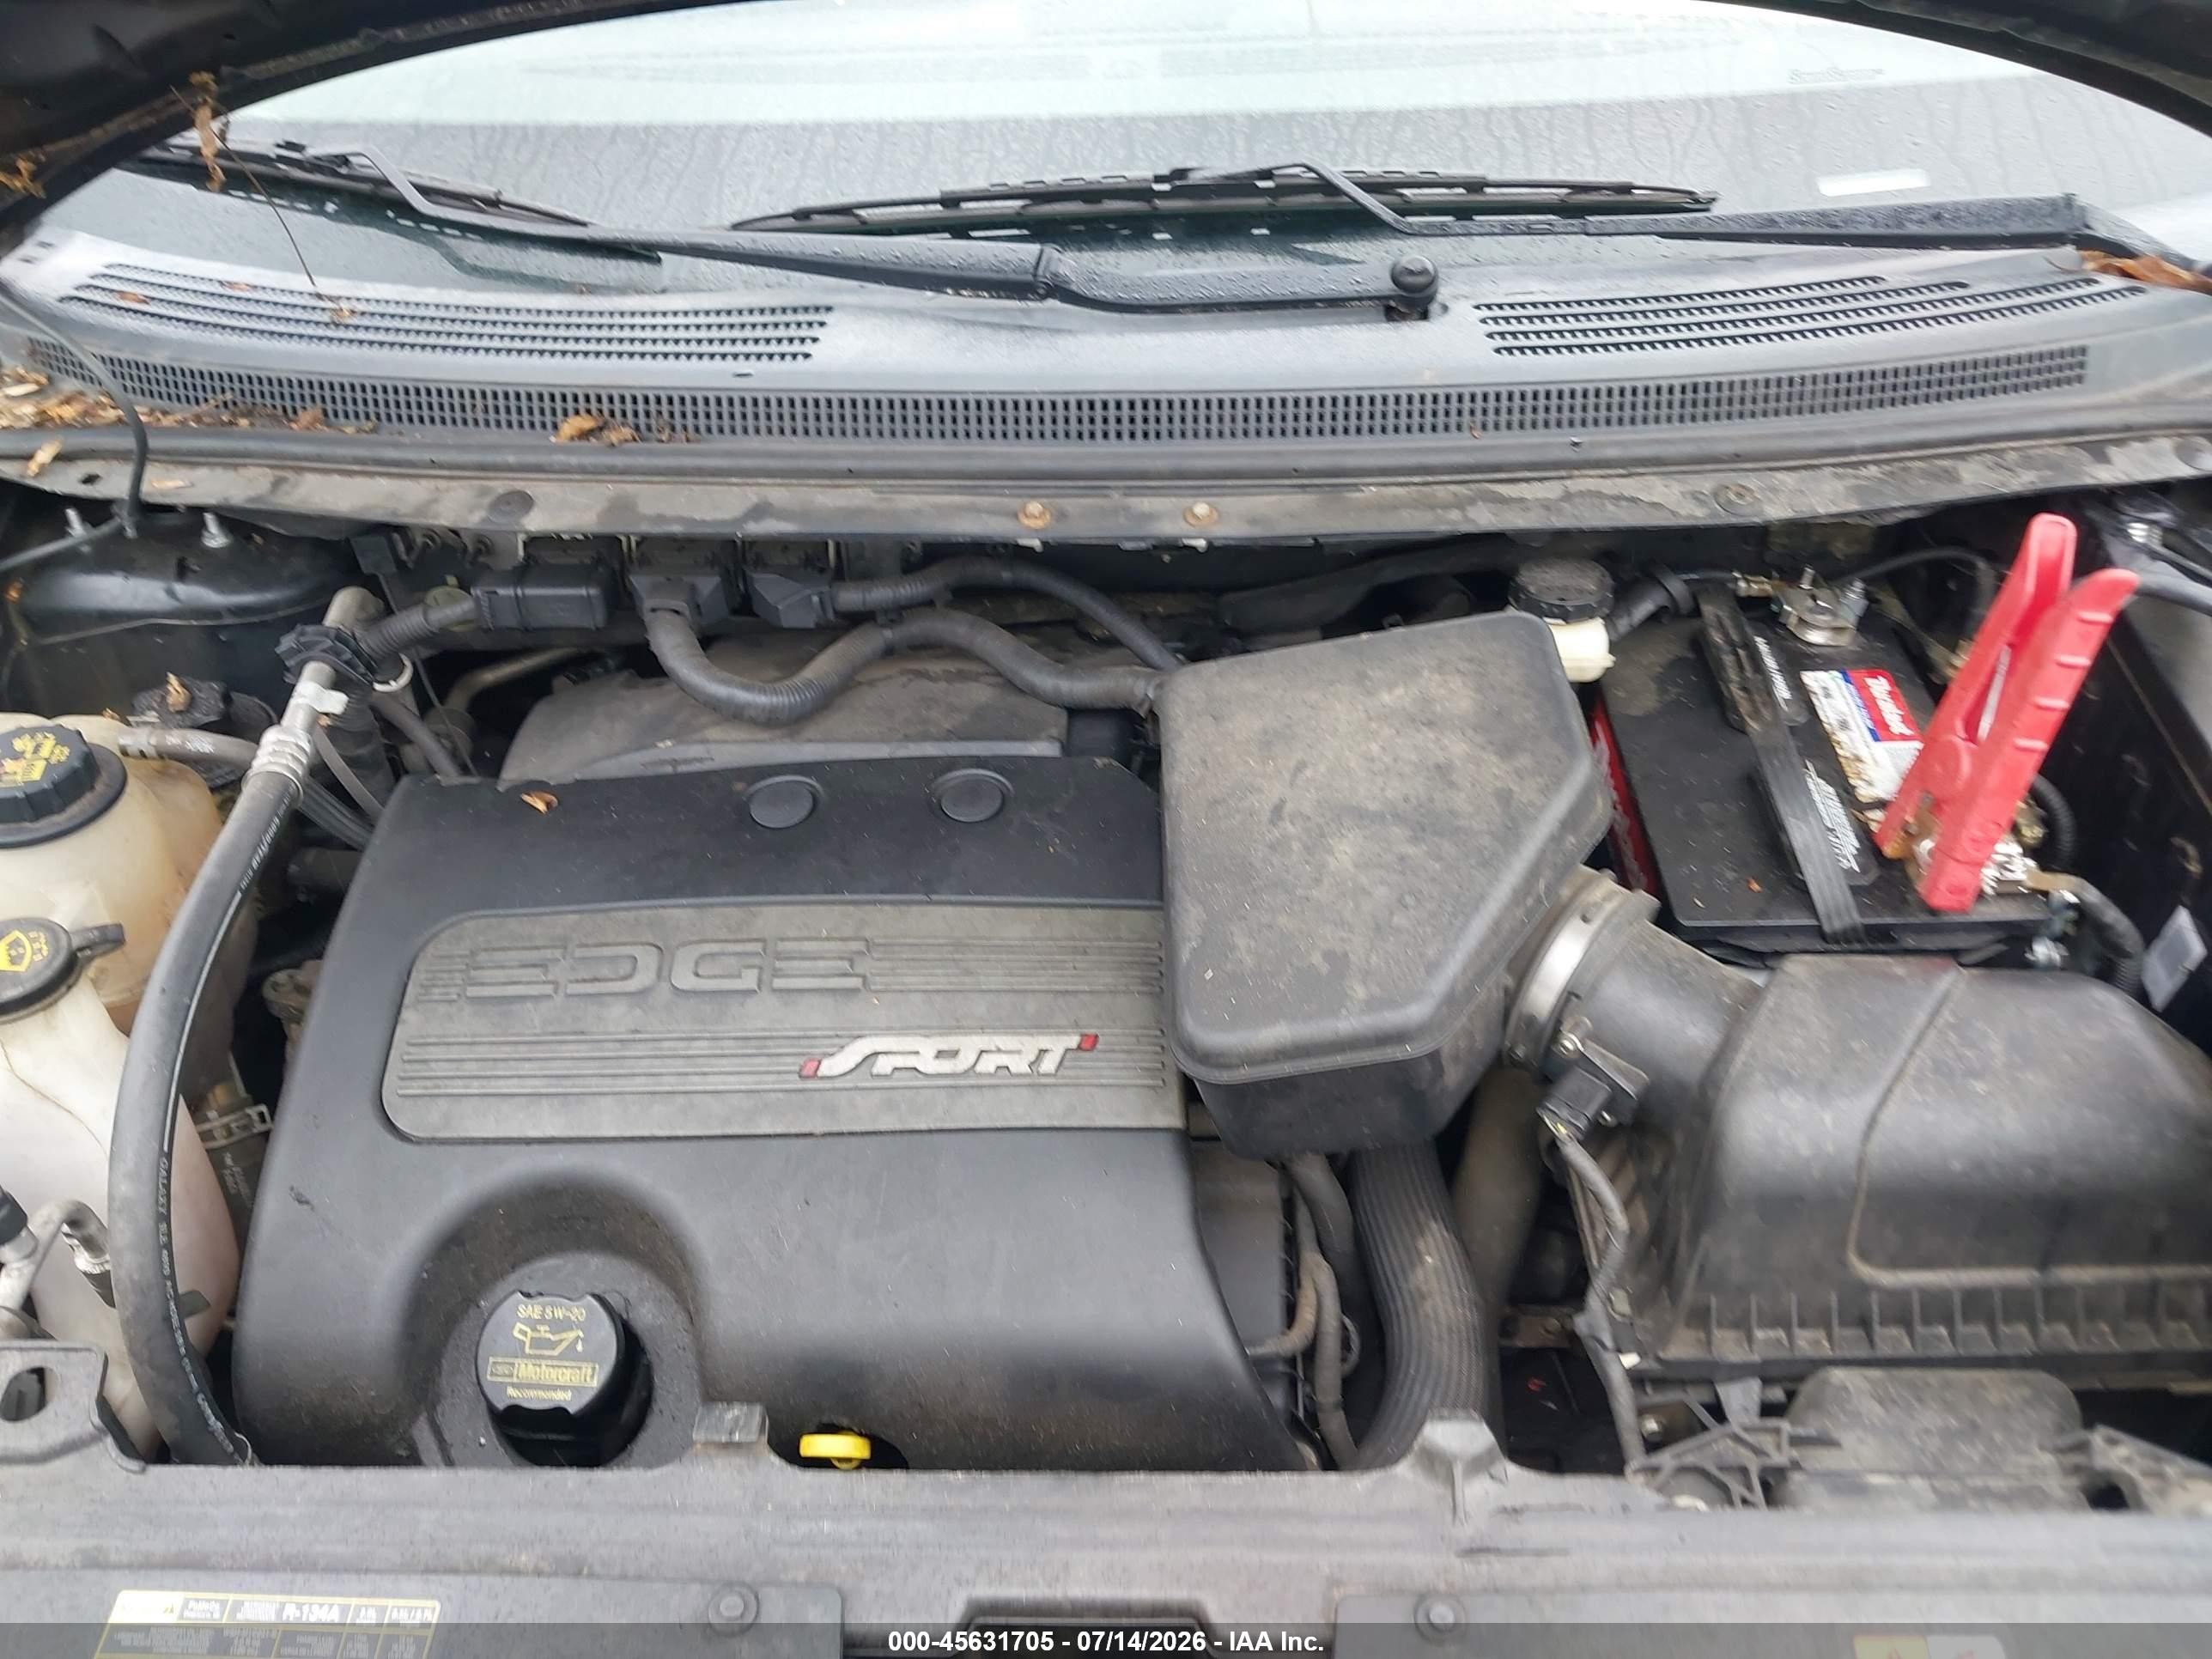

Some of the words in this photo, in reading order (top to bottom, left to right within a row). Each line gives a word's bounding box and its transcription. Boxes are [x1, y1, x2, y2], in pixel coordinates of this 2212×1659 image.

[466, 938, 870, 999] EDGE
[799, 1032, 1098, 1079] SPORT
[517, 1304, 544, 1320] SAE
[544, 1304, 586, 1322] 5W-20
[516, 1362, 593, 1383] Motorcraft
[506, 1386, 572, 1401] Recommended
